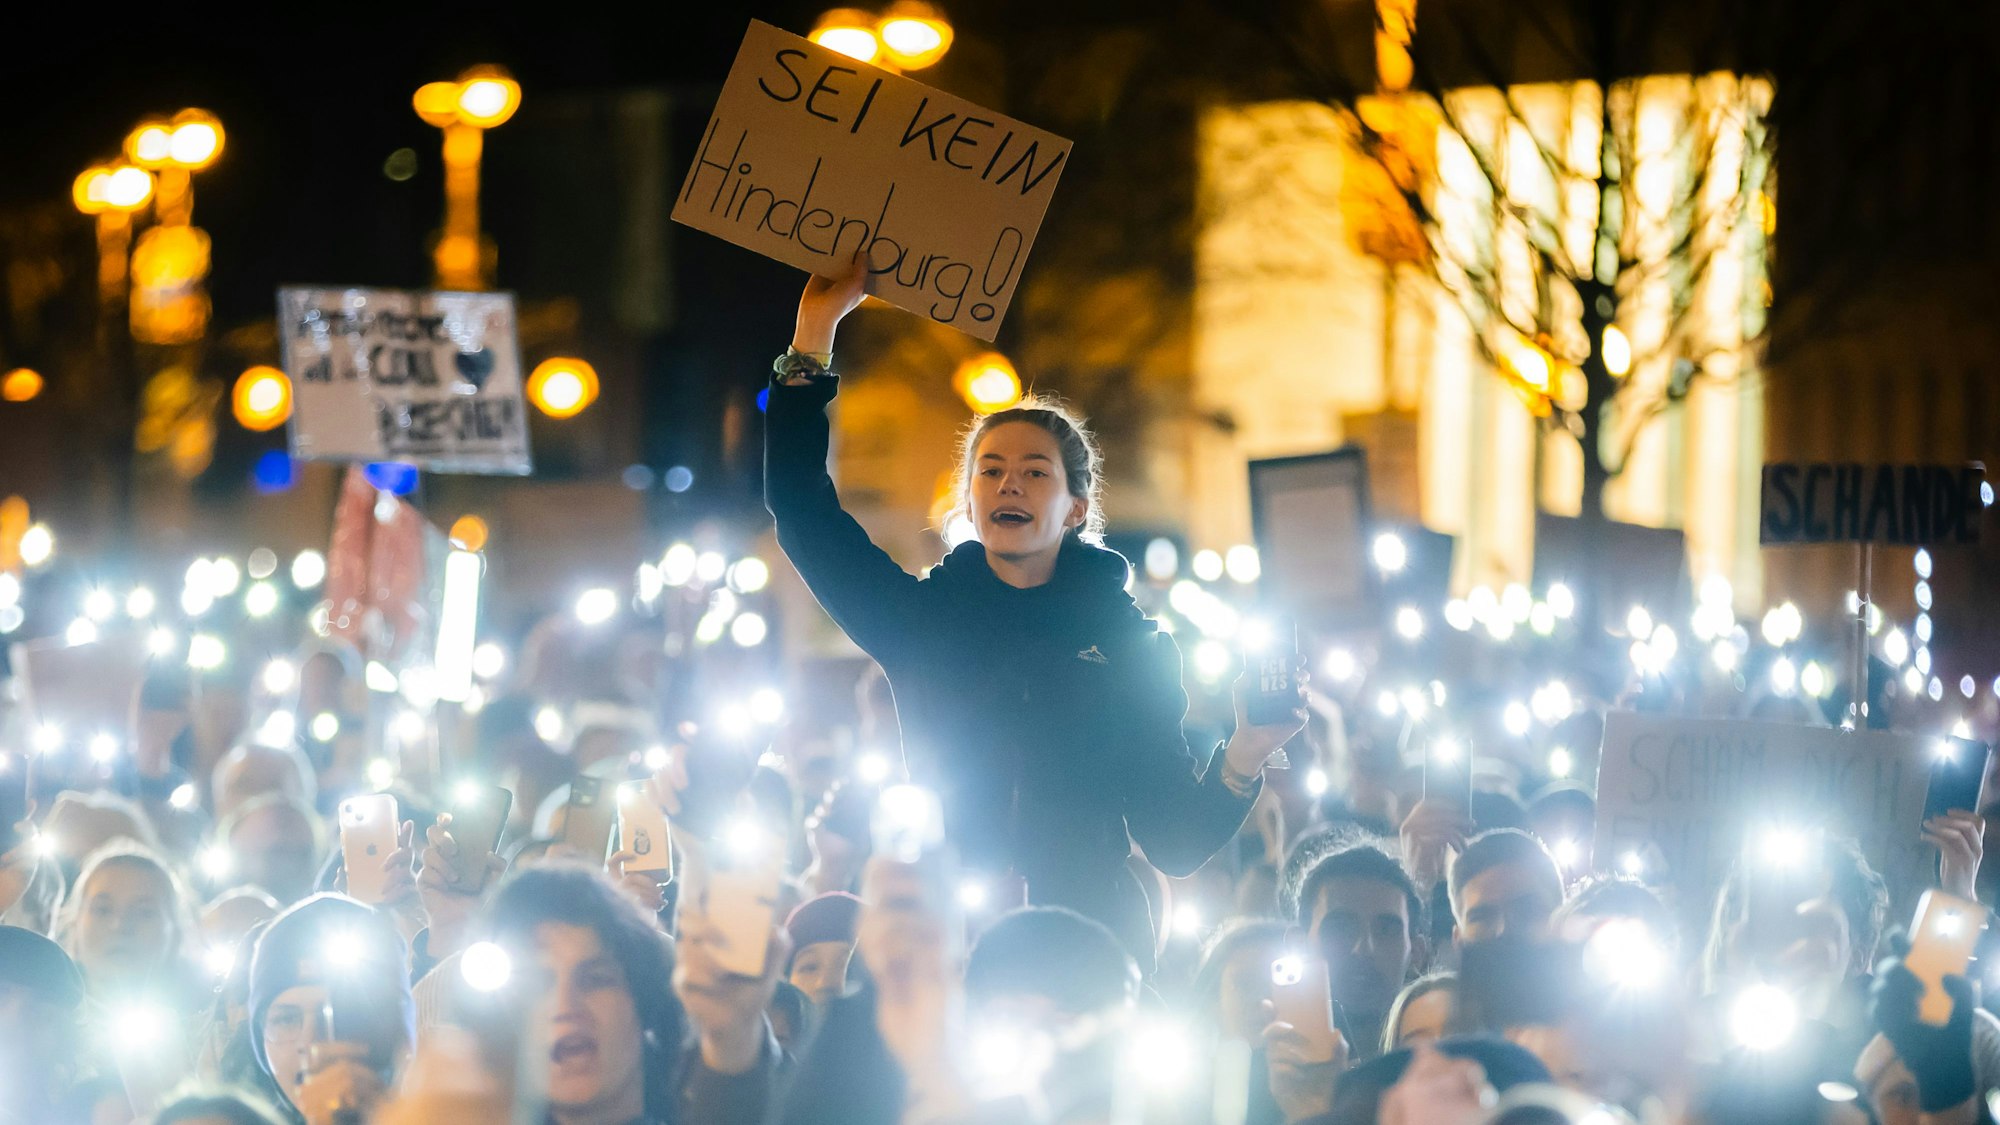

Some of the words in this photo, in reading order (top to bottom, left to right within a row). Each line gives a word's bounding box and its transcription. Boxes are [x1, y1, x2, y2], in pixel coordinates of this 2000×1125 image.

[758, 49, 883, 134] SEI
[899, 97, 1065, 195] KEIN
[1764, 463, 1981, 543] SCHANDE
